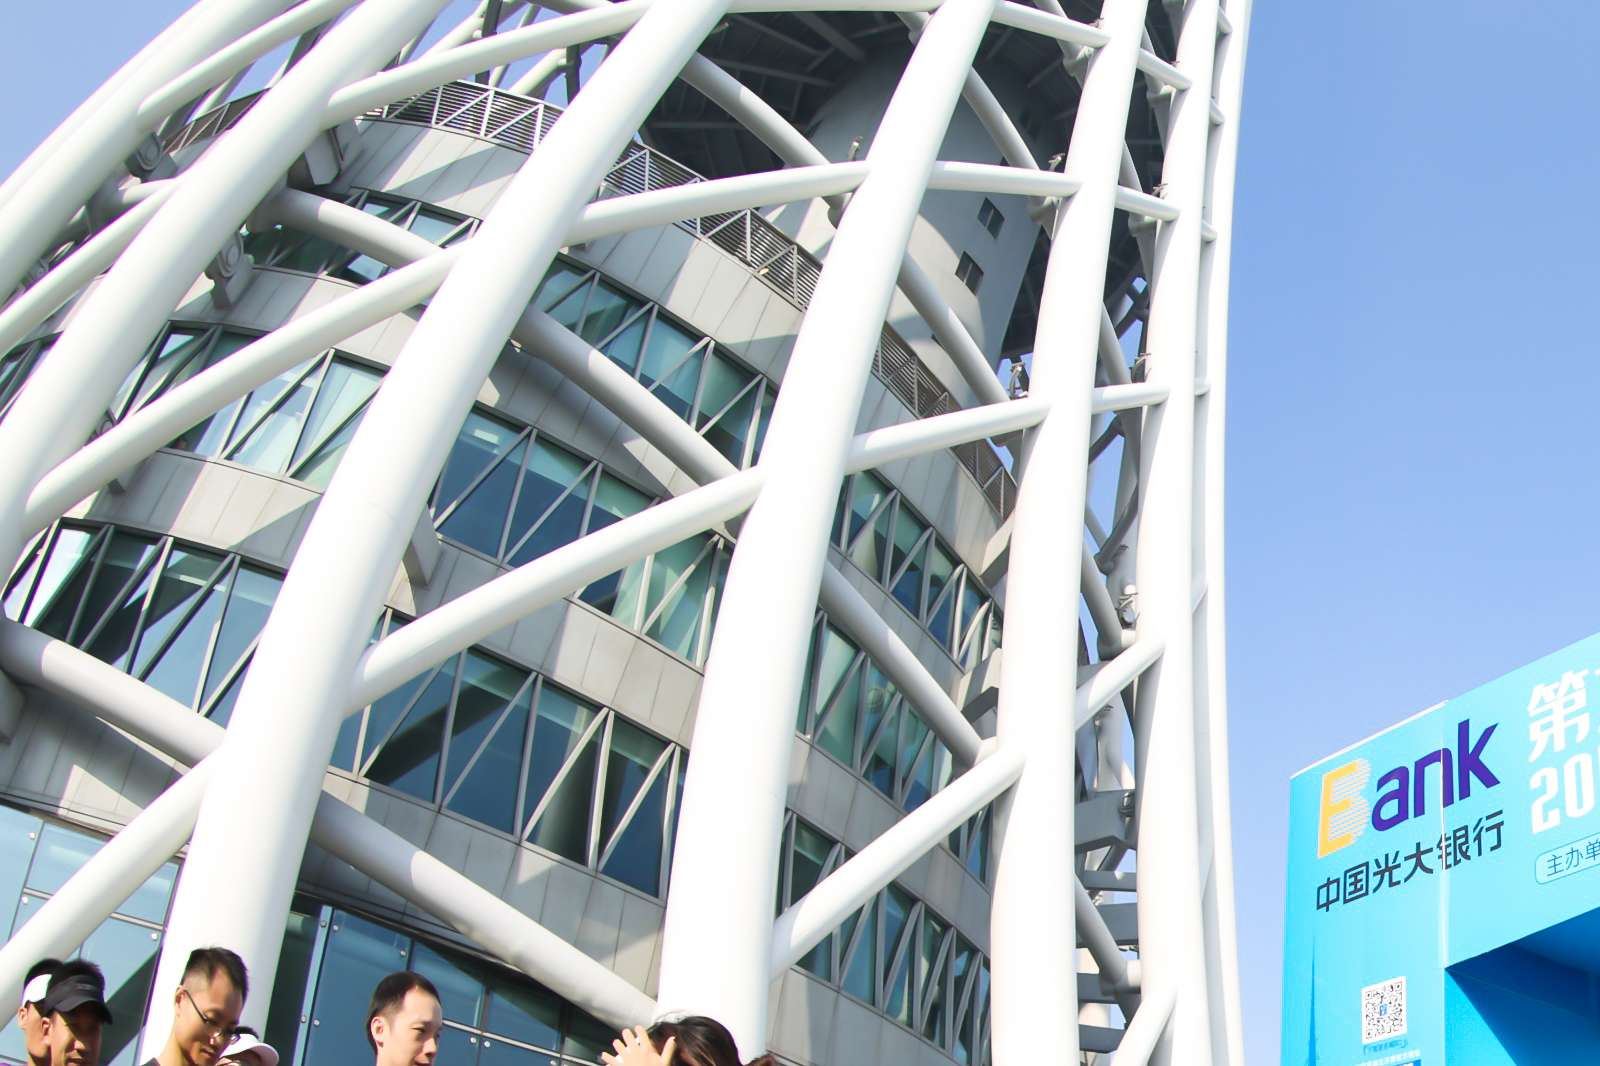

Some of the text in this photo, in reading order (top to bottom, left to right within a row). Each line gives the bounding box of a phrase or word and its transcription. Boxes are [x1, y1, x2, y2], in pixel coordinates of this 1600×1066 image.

[1317, 718, 1500, 858] Bank
[1316, 809, 1505, 912] 中国光大银行
